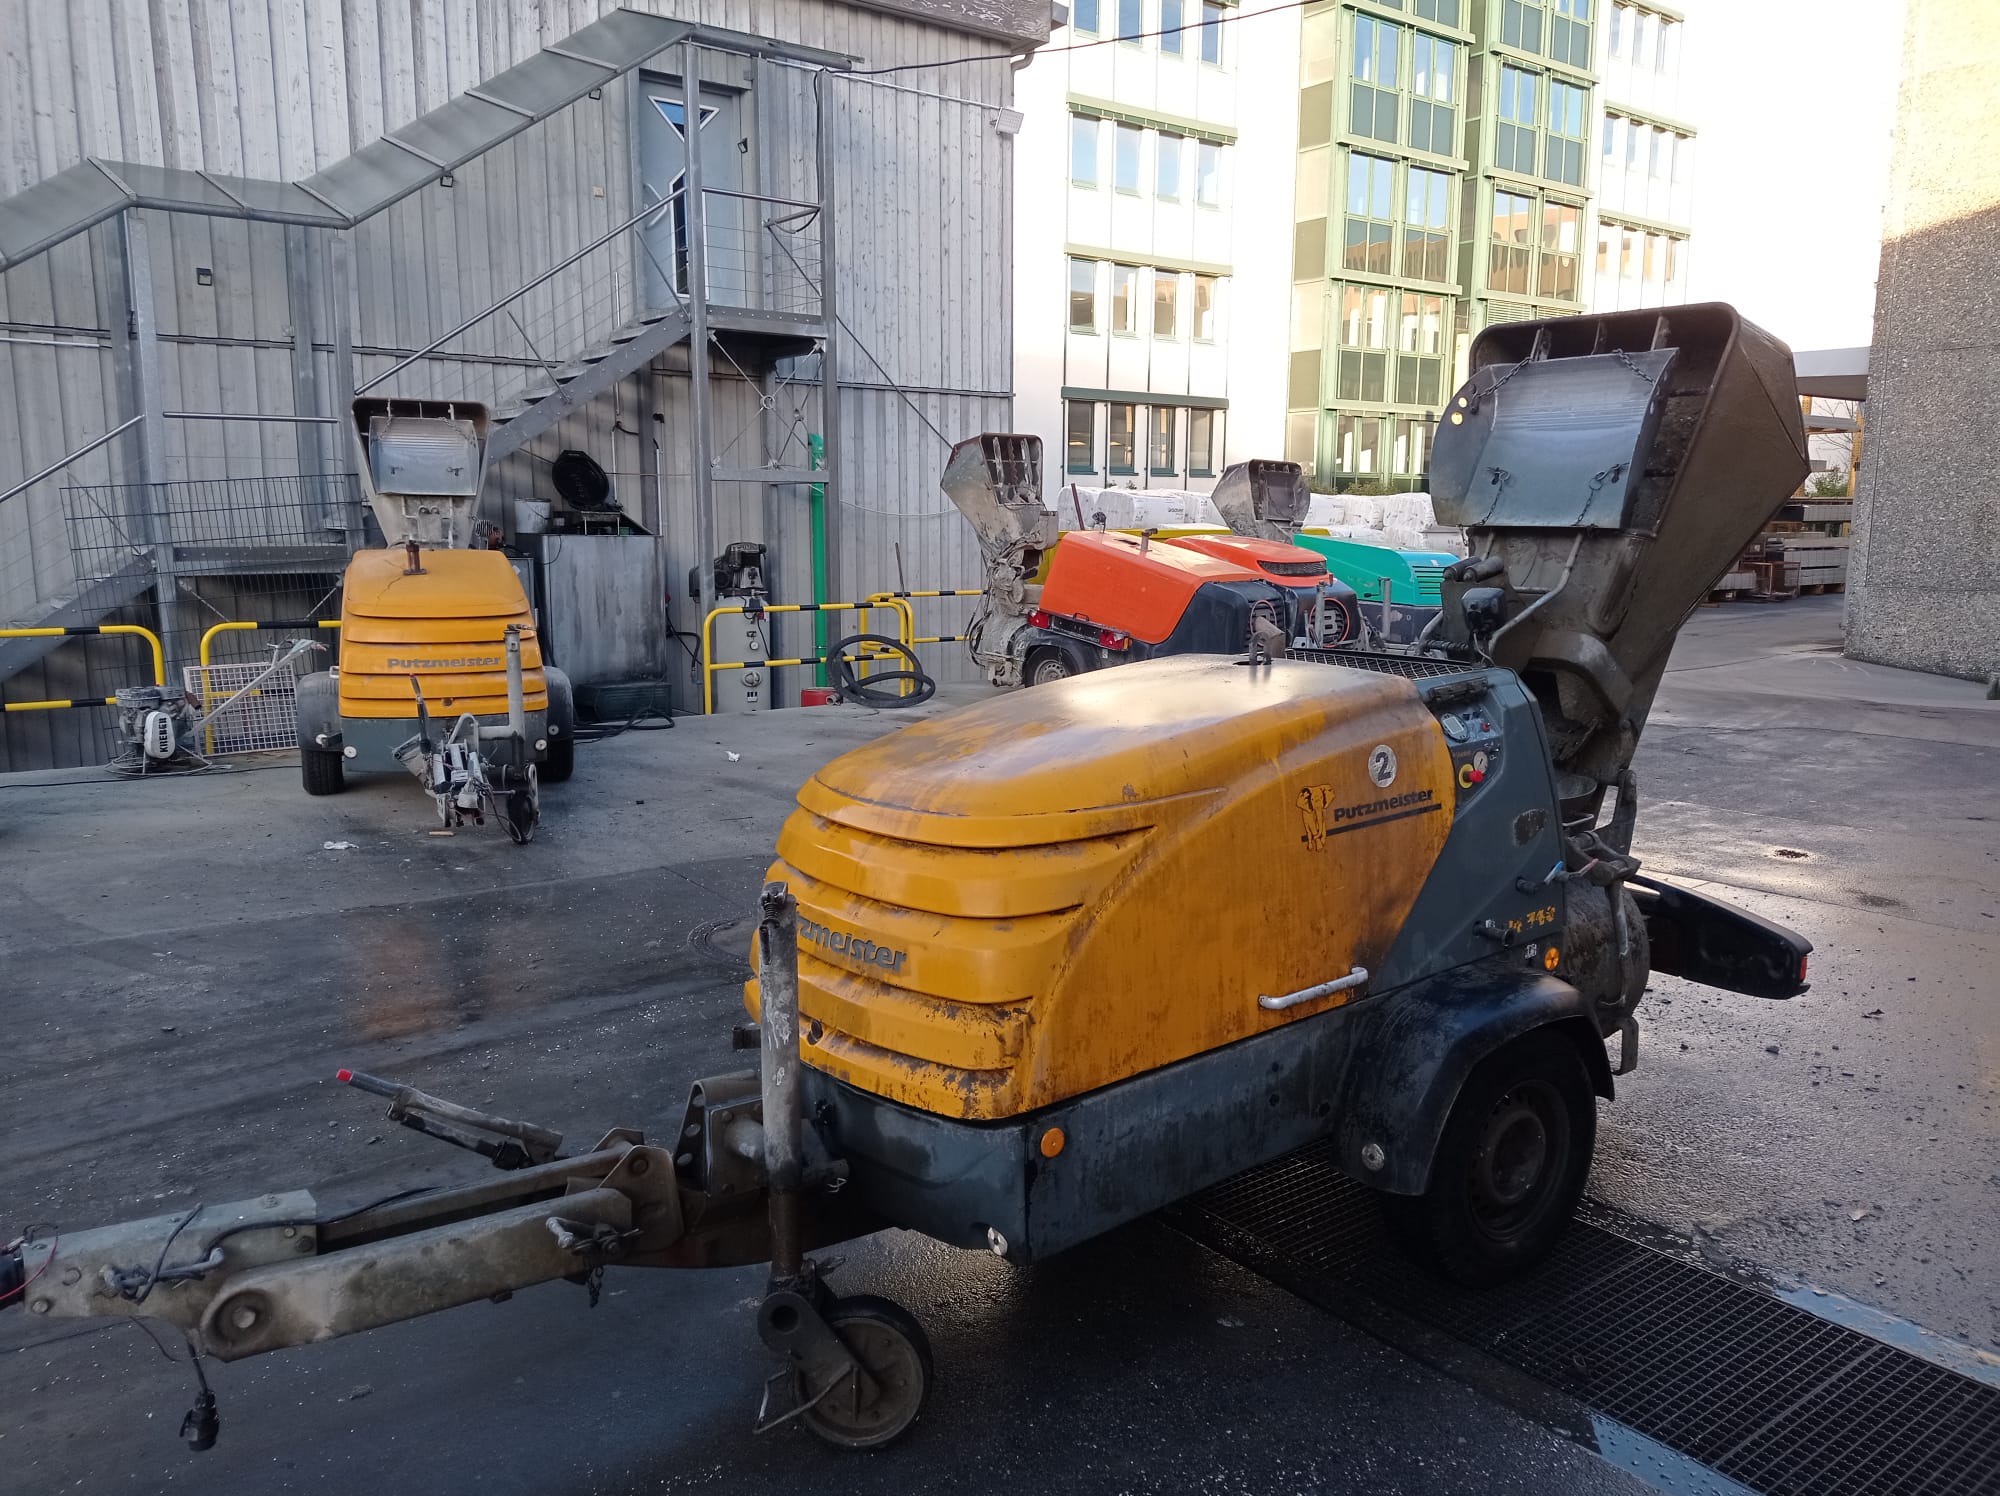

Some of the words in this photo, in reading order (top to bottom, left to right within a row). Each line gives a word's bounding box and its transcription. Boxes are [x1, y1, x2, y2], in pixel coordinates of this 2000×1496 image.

[387, 656, 501, 669] Putzmeister
[1375, 751, 1393, 782] 2
[1334, 789, 1434, 822] Putzmeister
[797, 914, 908, 972] zmeister
